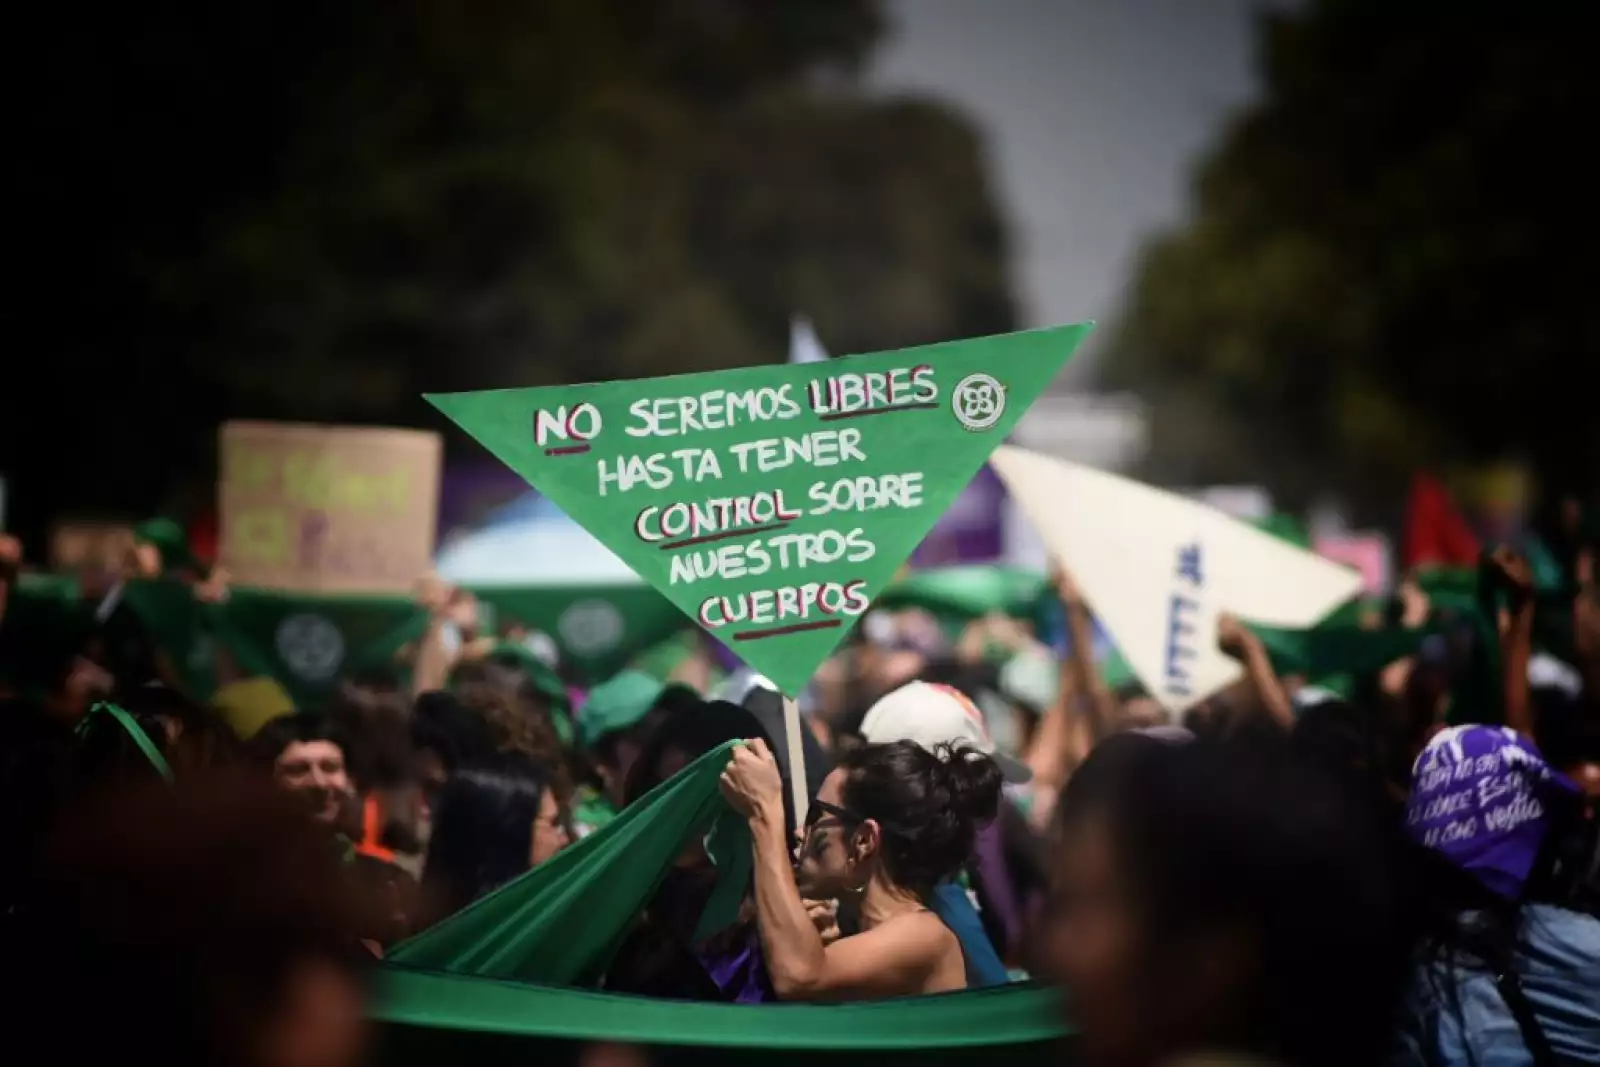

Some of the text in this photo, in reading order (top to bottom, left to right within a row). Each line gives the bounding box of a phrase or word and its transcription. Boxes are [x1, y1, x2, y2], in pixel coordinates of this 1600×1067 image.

[534, 364, 938, 446] NO SEREMOS LIBRES
[597, 427, 867, 496] HASTA TENER
[634, 472, 924, 543] CONTROL SOBRE
[669, 527, 876, 585] NUESTROS
[697, 579, 870, 628] CUERPOS
